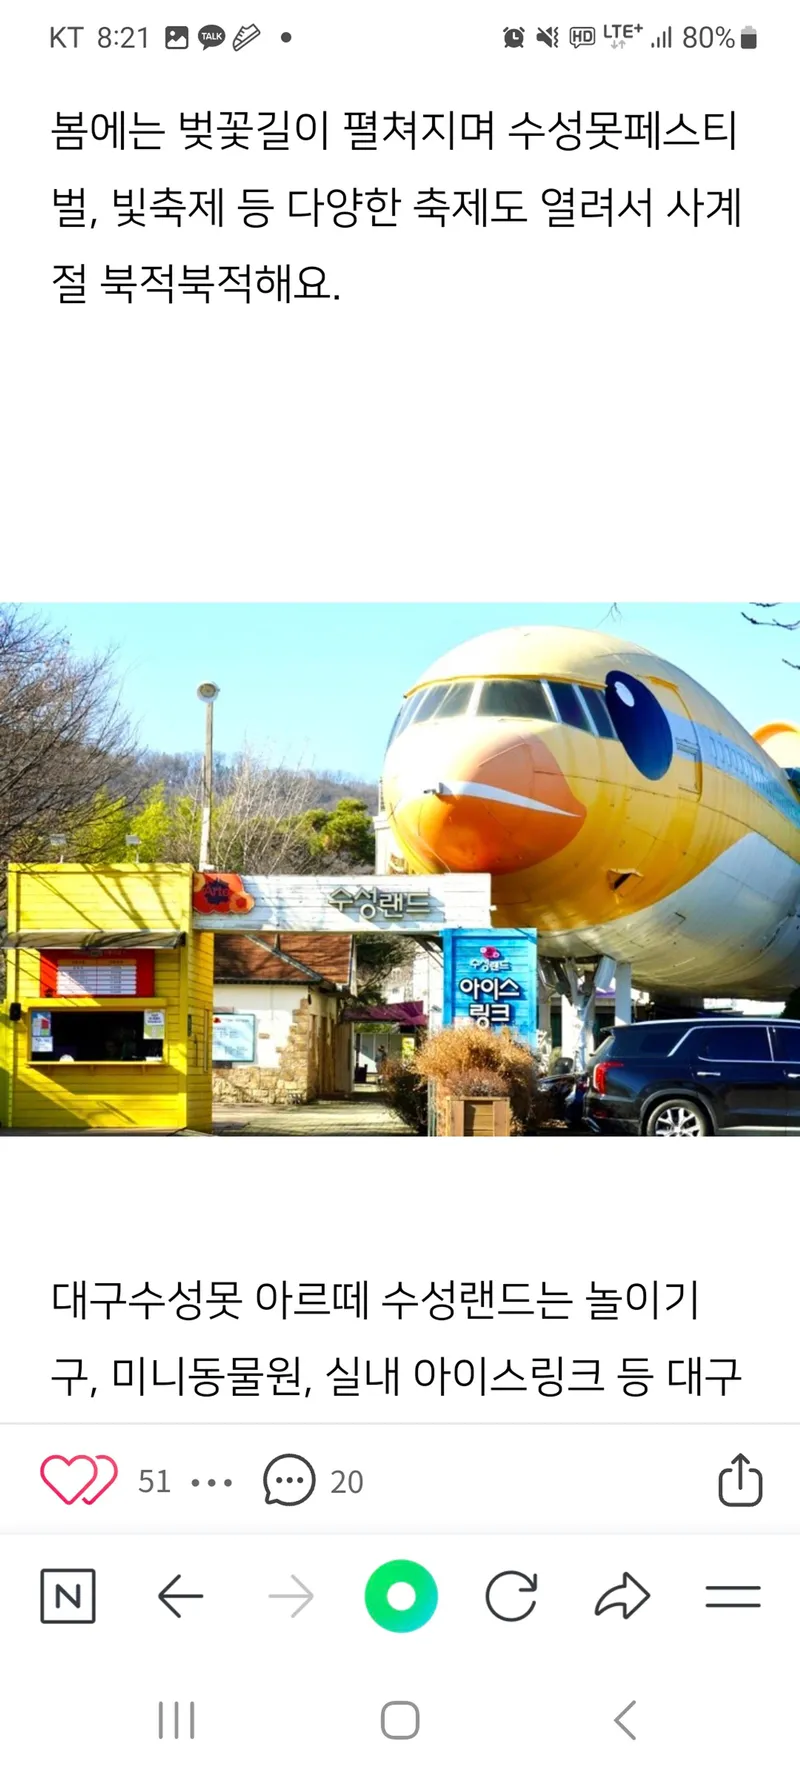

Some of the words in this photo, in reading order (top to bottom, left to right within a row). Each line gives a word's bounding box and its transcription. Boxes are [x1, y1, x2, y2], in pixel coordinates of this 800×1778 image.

[51, 27, 84, 48] KT
[98, 27, 147, 48] 8:21
[201, 32, 223, 40] TALK
[572, 30, 593, 42] HD
[603, 23, 643, 38] LTE+
[683, 26, 735, 48] 80%
[51, 111, 166, 151] 봄에는
[180, 111, 328, 151] 벚꽃길이
[343, 111, 494, 151] 펼쳐지며
[508, 111, 736, 152] 수성못페스티
[53, 188, 98, 230] 벌,
[113, 187, 223, 228] 빛축제
[237, 189, 275, 229] 등
[288, 187, 402, 229] 다양한
[413, 187, 528, 228] 축제도
[541, 188, 652, 228] 열려서
[666, 188, 741, 228] 사계
[52, 264, 86, 304] 절
[100, 264, 340, 305] 북적북적해요.
[327, 886, 430, 919] 수성랜드
[460, 977, 520, 1001] 아이스
[469, 1003, 510, 1028] 링크
[53, 1280, 243, 1321] 대구수성못
[256, 1280, 368, 1321] 아르떼
[381, 1280, 574, 1321] 수성랜드는
[585, 1280, 698, 1321] 놀이기
[51, 1358, 97, 1399] 구,
[113, 1357, 312, 1399] 미니동물원,
[325, 1357, 399, 1397] 실내
[414, 1356, 605, 1398] 아이스링크
[616, 1358, 655, 1398] 등
[668, 1357, 742, 1397] 대구
[138, 1470, 171, 1493] 51
[331, 1470, 364, 1494] 20
